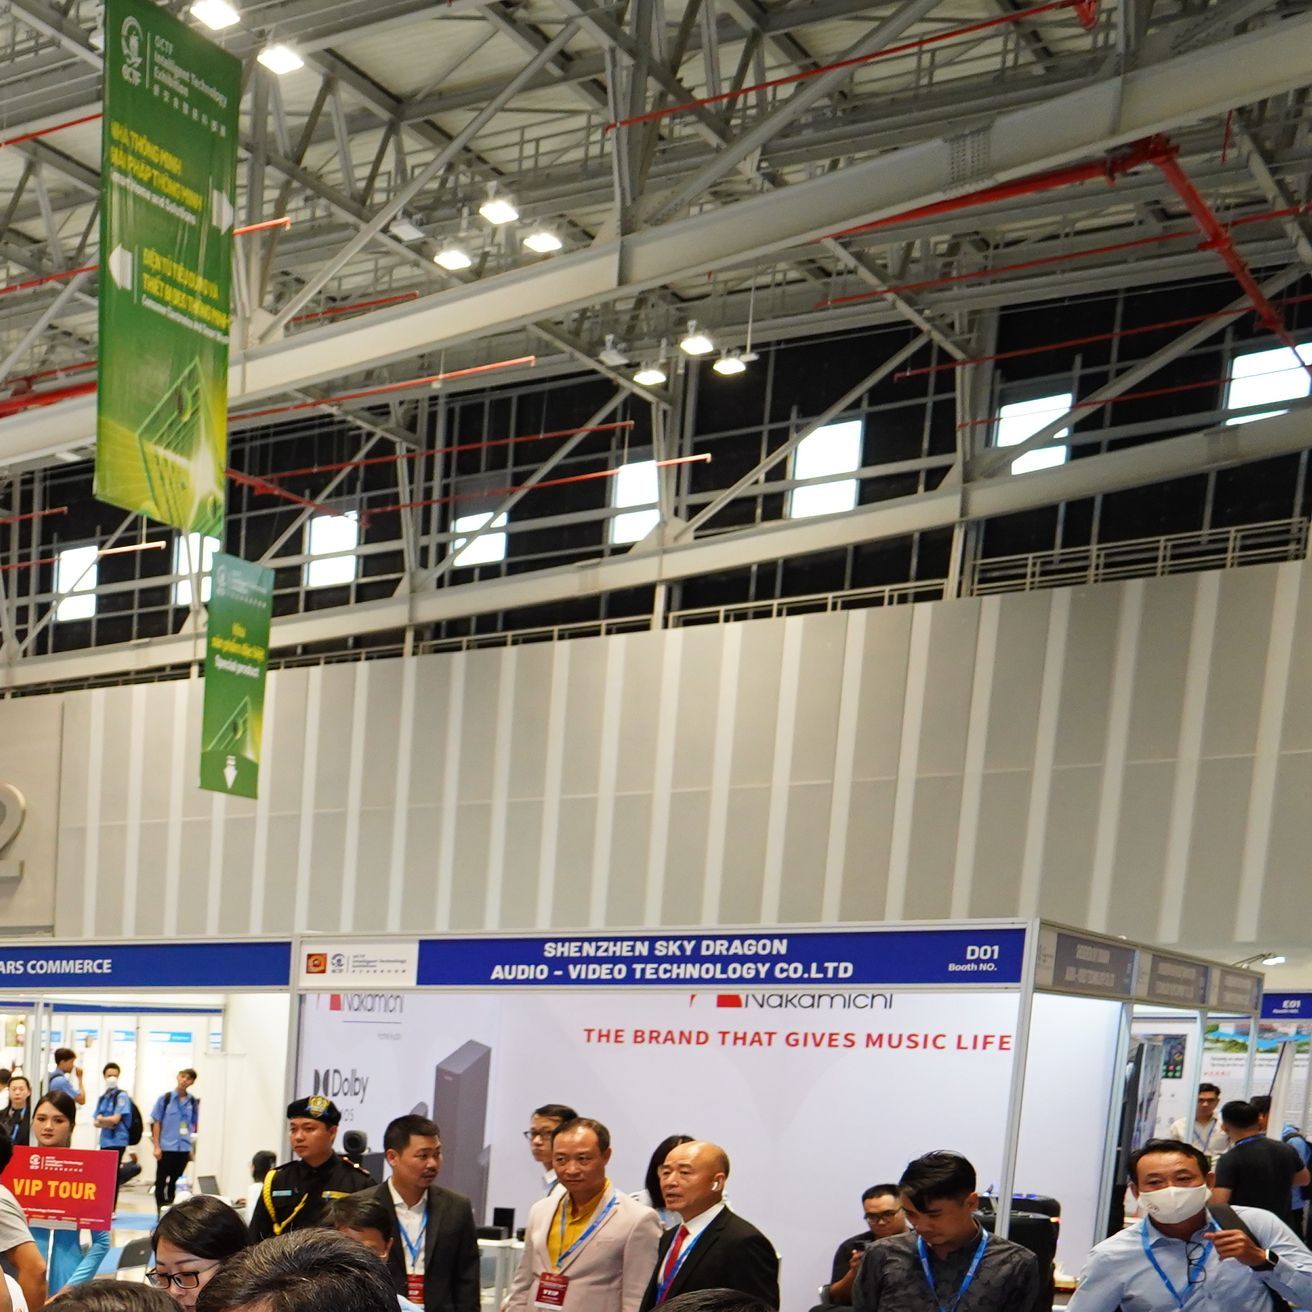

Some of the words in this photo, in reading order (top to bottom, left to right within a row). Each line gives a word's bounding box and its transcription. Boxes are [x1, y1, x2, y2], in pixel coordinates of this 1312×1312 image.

[543, 940, 649, 957] SHENZHEN
[654, 940, 695, 957] SKY
[700, 938, 788, 956] DRAGON
[966, 945, 999, 960] D01
[27, 959, 113, 974] COMMERCE
[491, 964, 550, 981] AUDIO
[568, 963, 627, 980] VIDEO
[632, 962, 771, 980] TECHNOLOGY
[774, 961, 853, 979] CO.LTD
[948, 962, 977, 972] Booth
[978, 961, 998, 972] NO.
[1281, 1000, 1301, 1009] E01
[584, 1027, 625, 1044] THE
[632, 1029, 710, 1046] BRAND
[719, 1031, 777, 1047] THAT
[785, 1032, 857, 1049] GIVES
[865, 1033, 947, 1050] MUSIC
[955, 1034, 1013, 1051] LIFE
[331, 1069, 369, 1104] Dolby
[13, 1178, 43, 1197] VIP
[47, 1180, 97, 1200] TOUR
